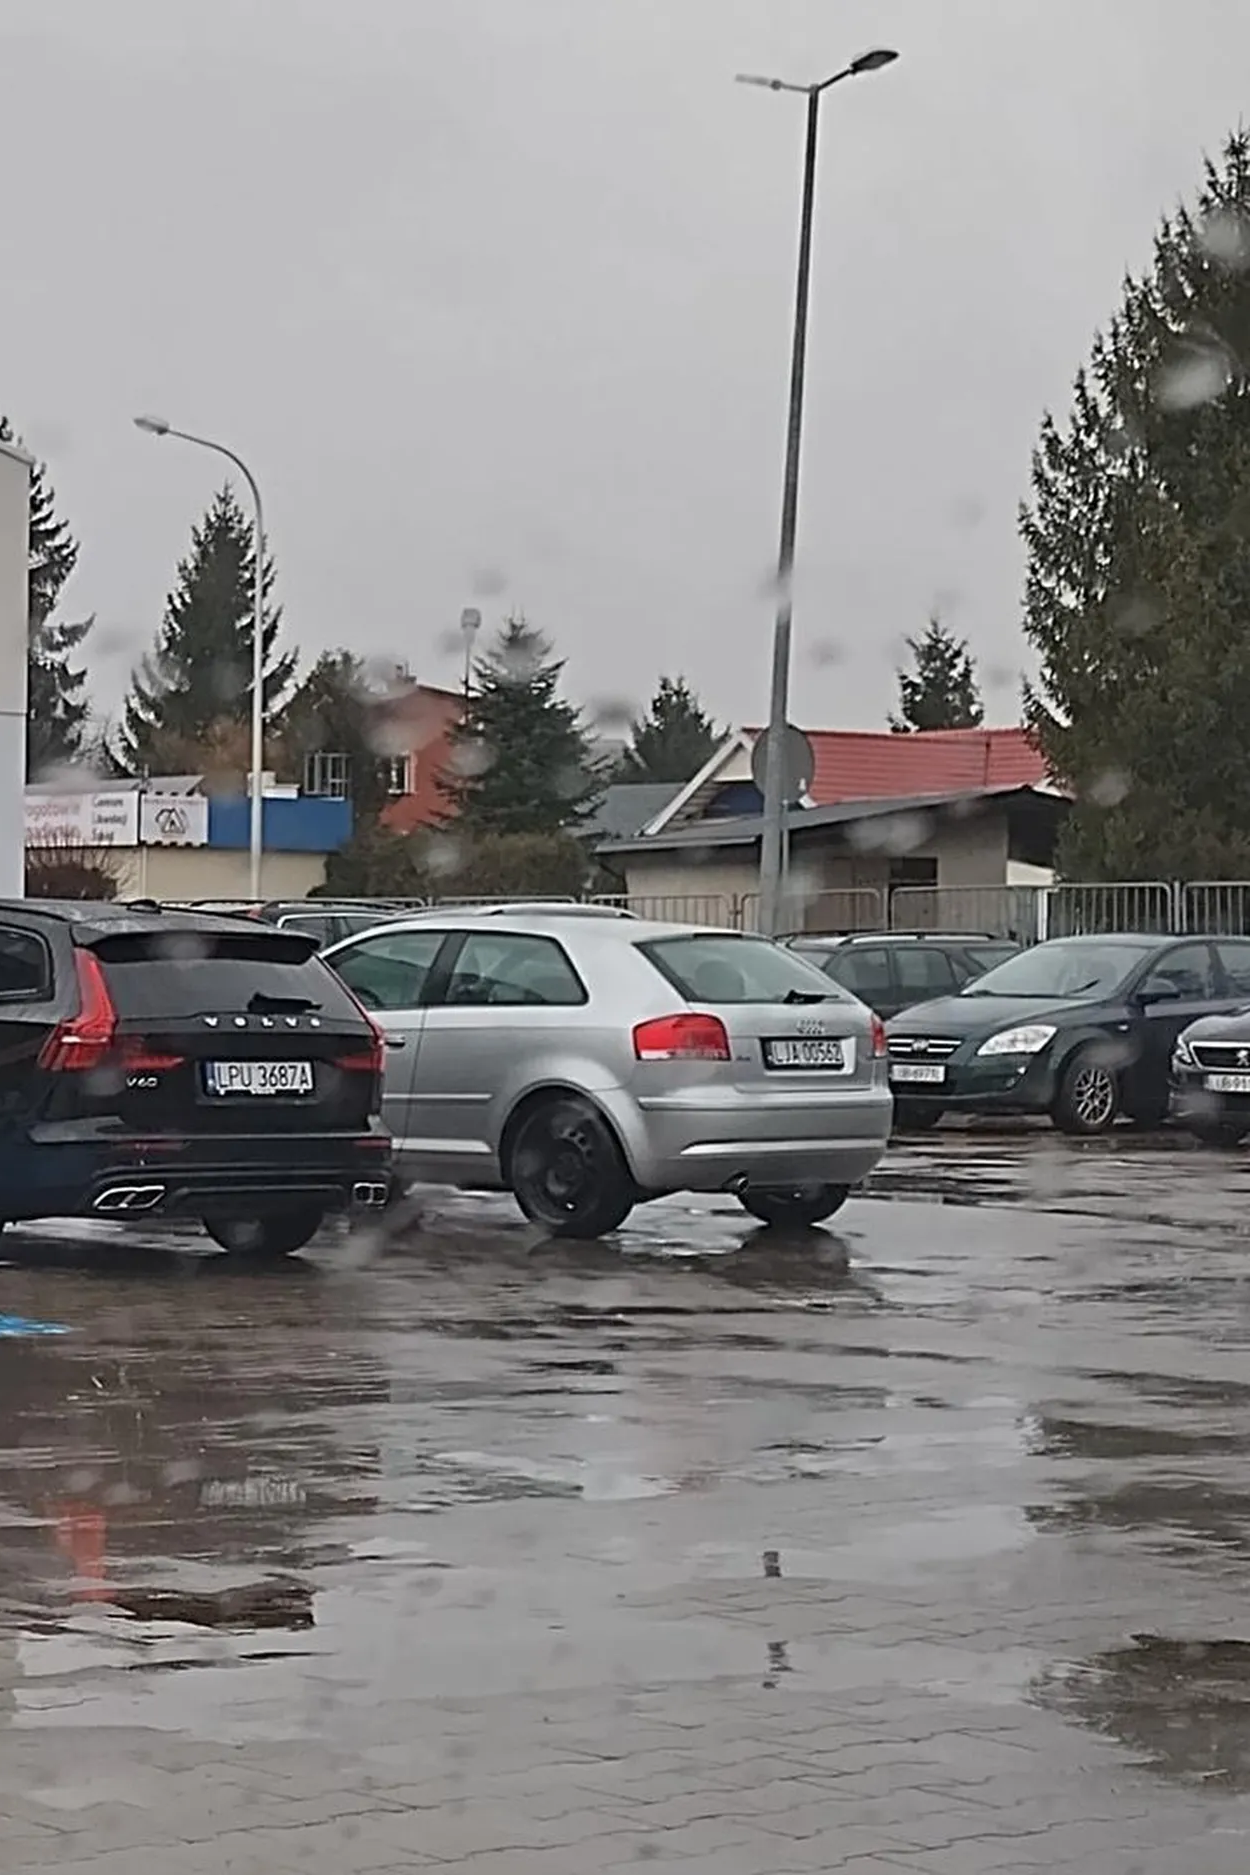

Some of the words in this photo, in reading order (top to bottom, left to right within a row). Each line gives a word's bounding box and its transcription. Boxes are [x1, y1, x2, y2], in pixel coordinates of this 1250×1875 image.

[204, 1016, 321, 1027] VOLVO
[125, 1076, 158, 1088] V60
[217, 1065, 252, 1088] LPU
[257, 1065, 310, 1088] 3687A
